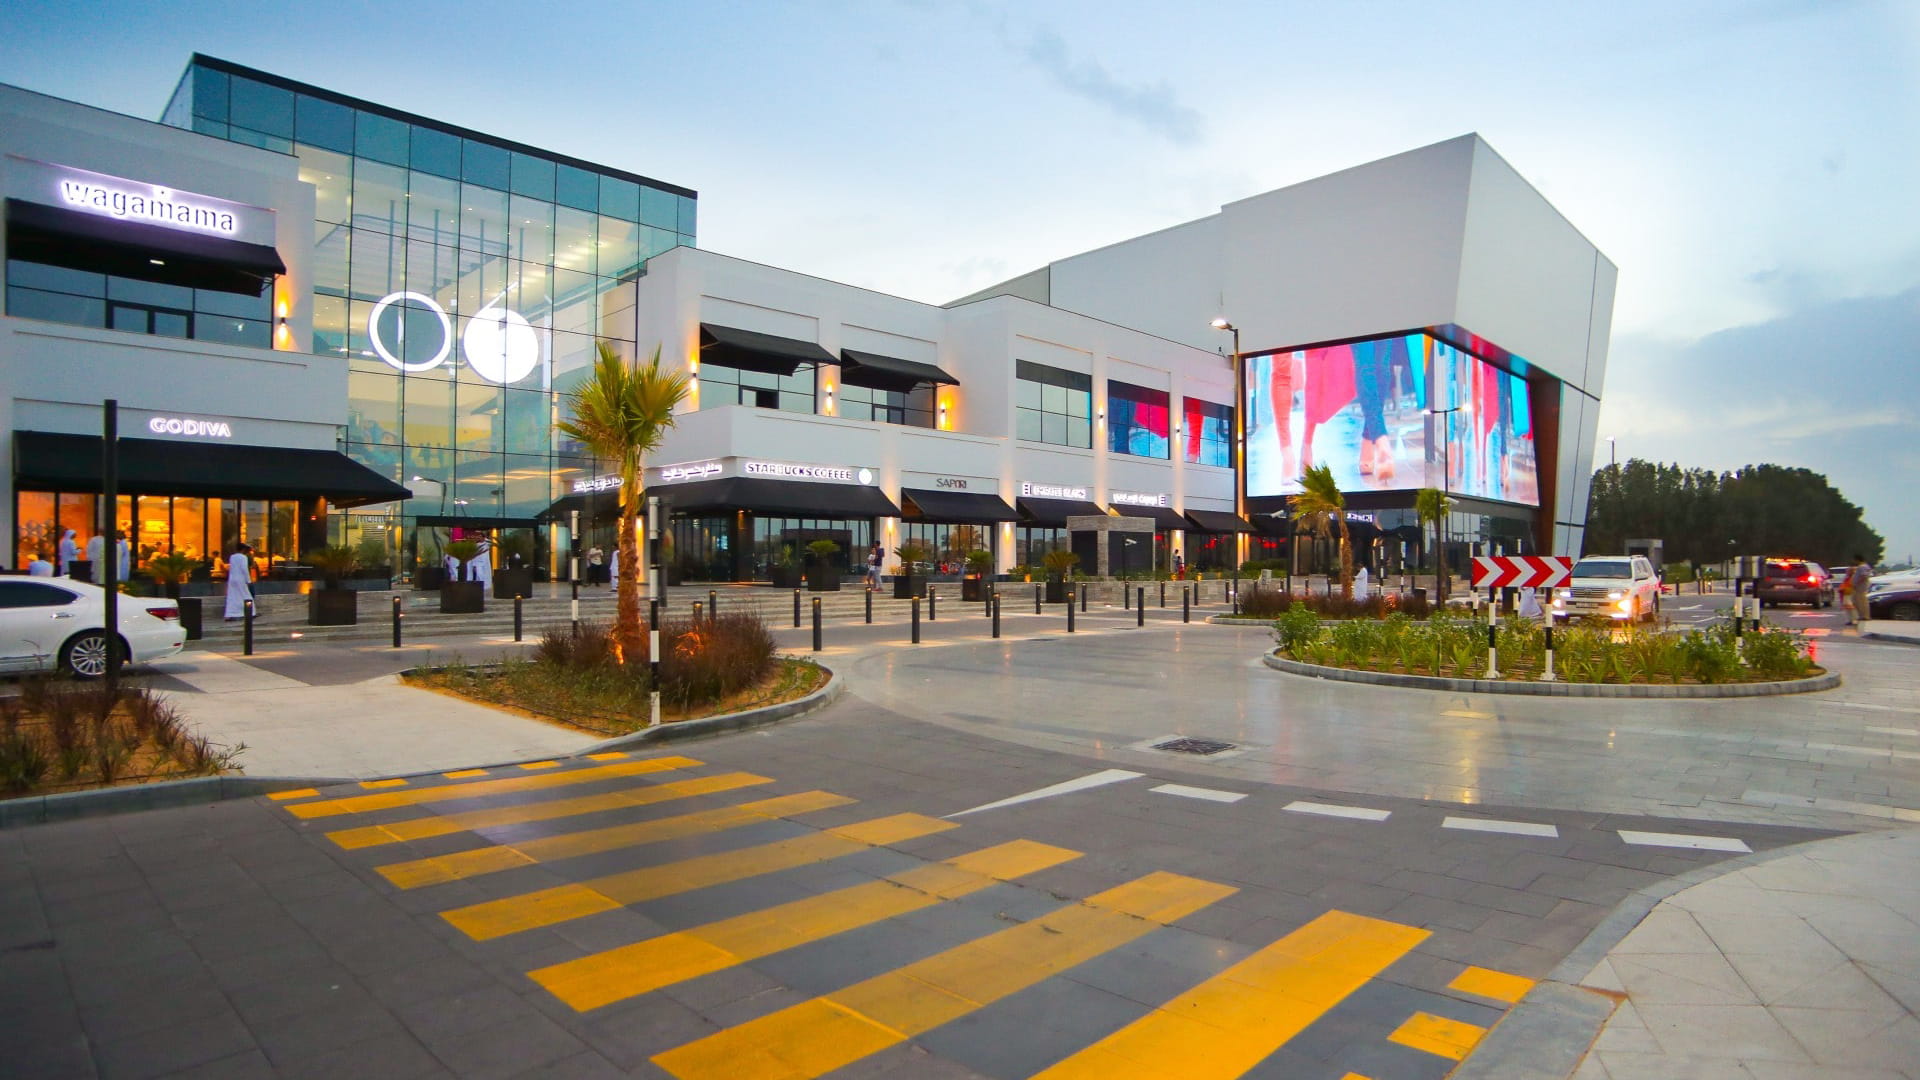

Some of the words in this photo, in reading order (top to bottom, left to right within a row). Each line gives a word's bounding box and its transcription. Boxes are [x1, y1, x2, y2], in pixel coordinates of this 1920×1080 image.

[63, 180, 236, 234] wagamama
[149, 416, 232, 438] GODIVA
[745, 461, 813, 477] STARBUCKS
[814, 467, 853, 481] COFFEE
